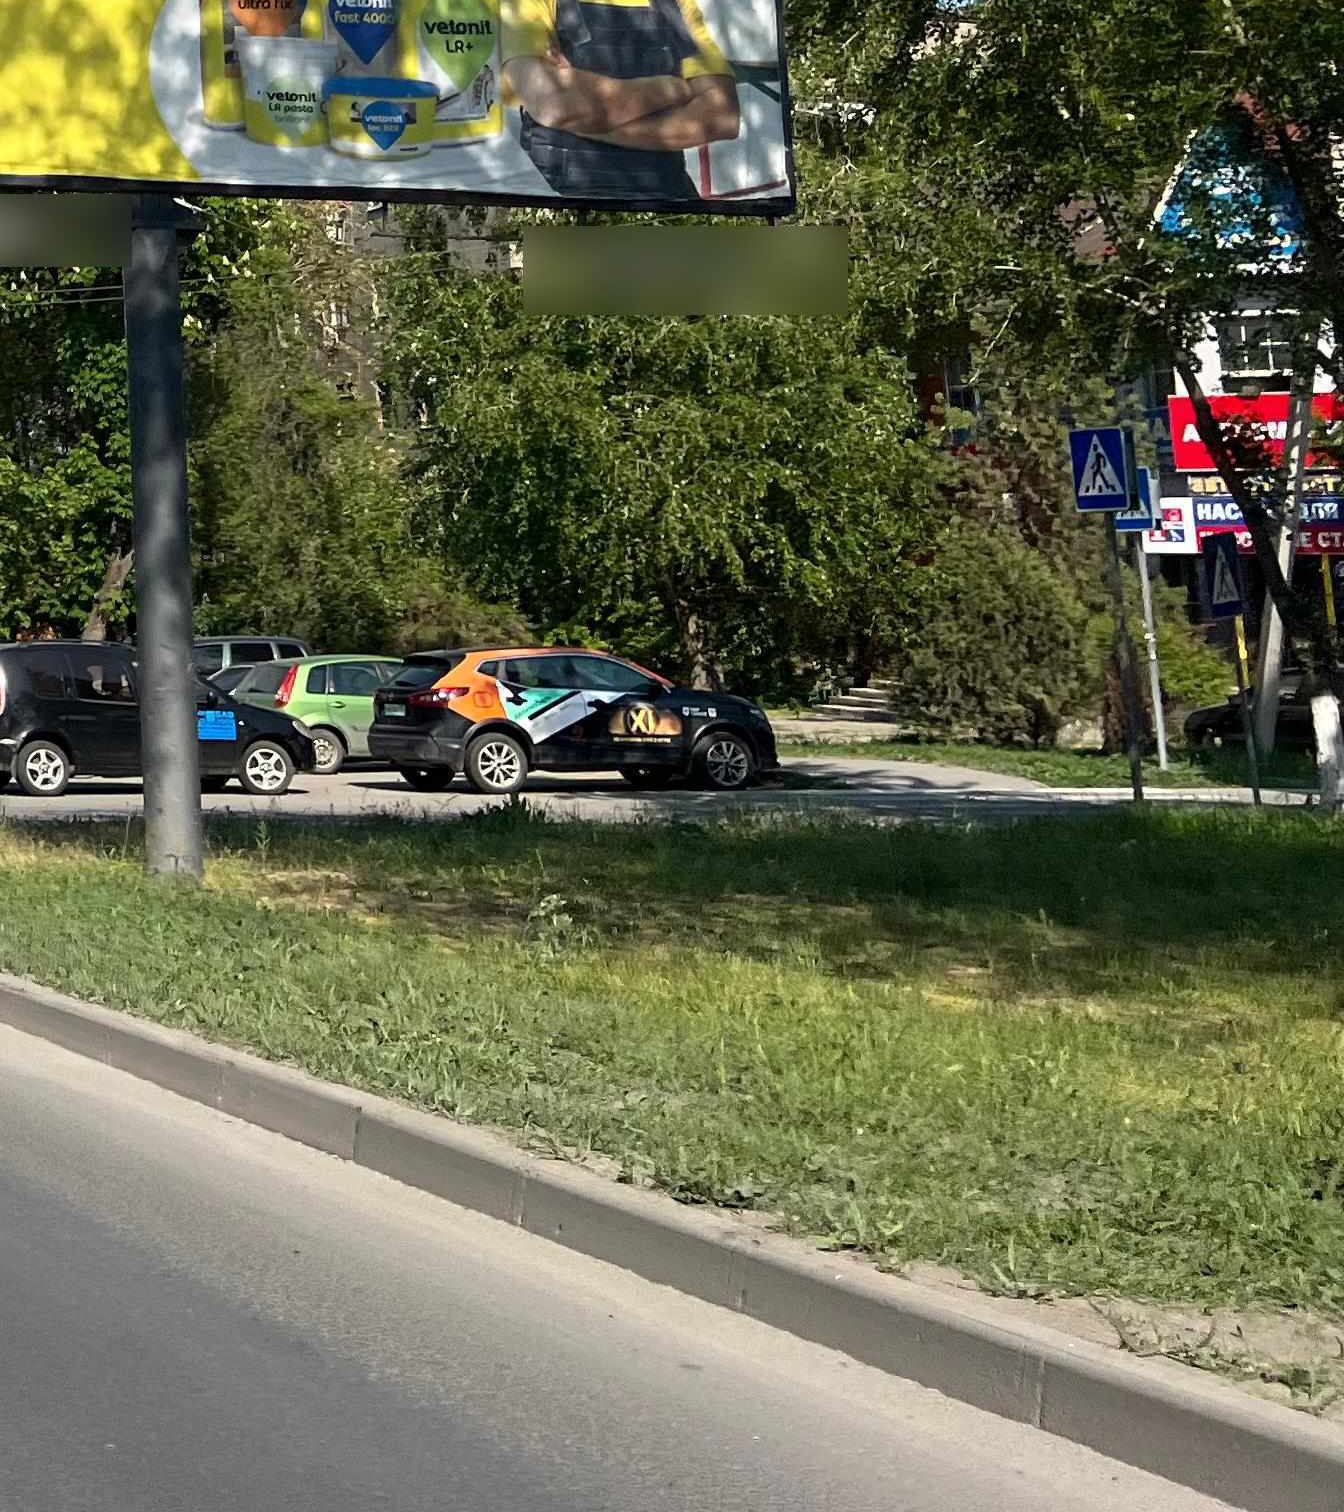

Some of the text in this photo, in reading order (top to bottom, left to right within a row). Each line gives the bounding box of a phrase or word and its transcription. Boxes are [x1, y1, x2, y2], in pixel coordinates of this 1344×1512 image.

[334, 10, 359, 24] fast
[423, 19, 493, 35] vetonit
[445, 39, 474, 54] LR+
[266, 91, 317, 103] vetonit
